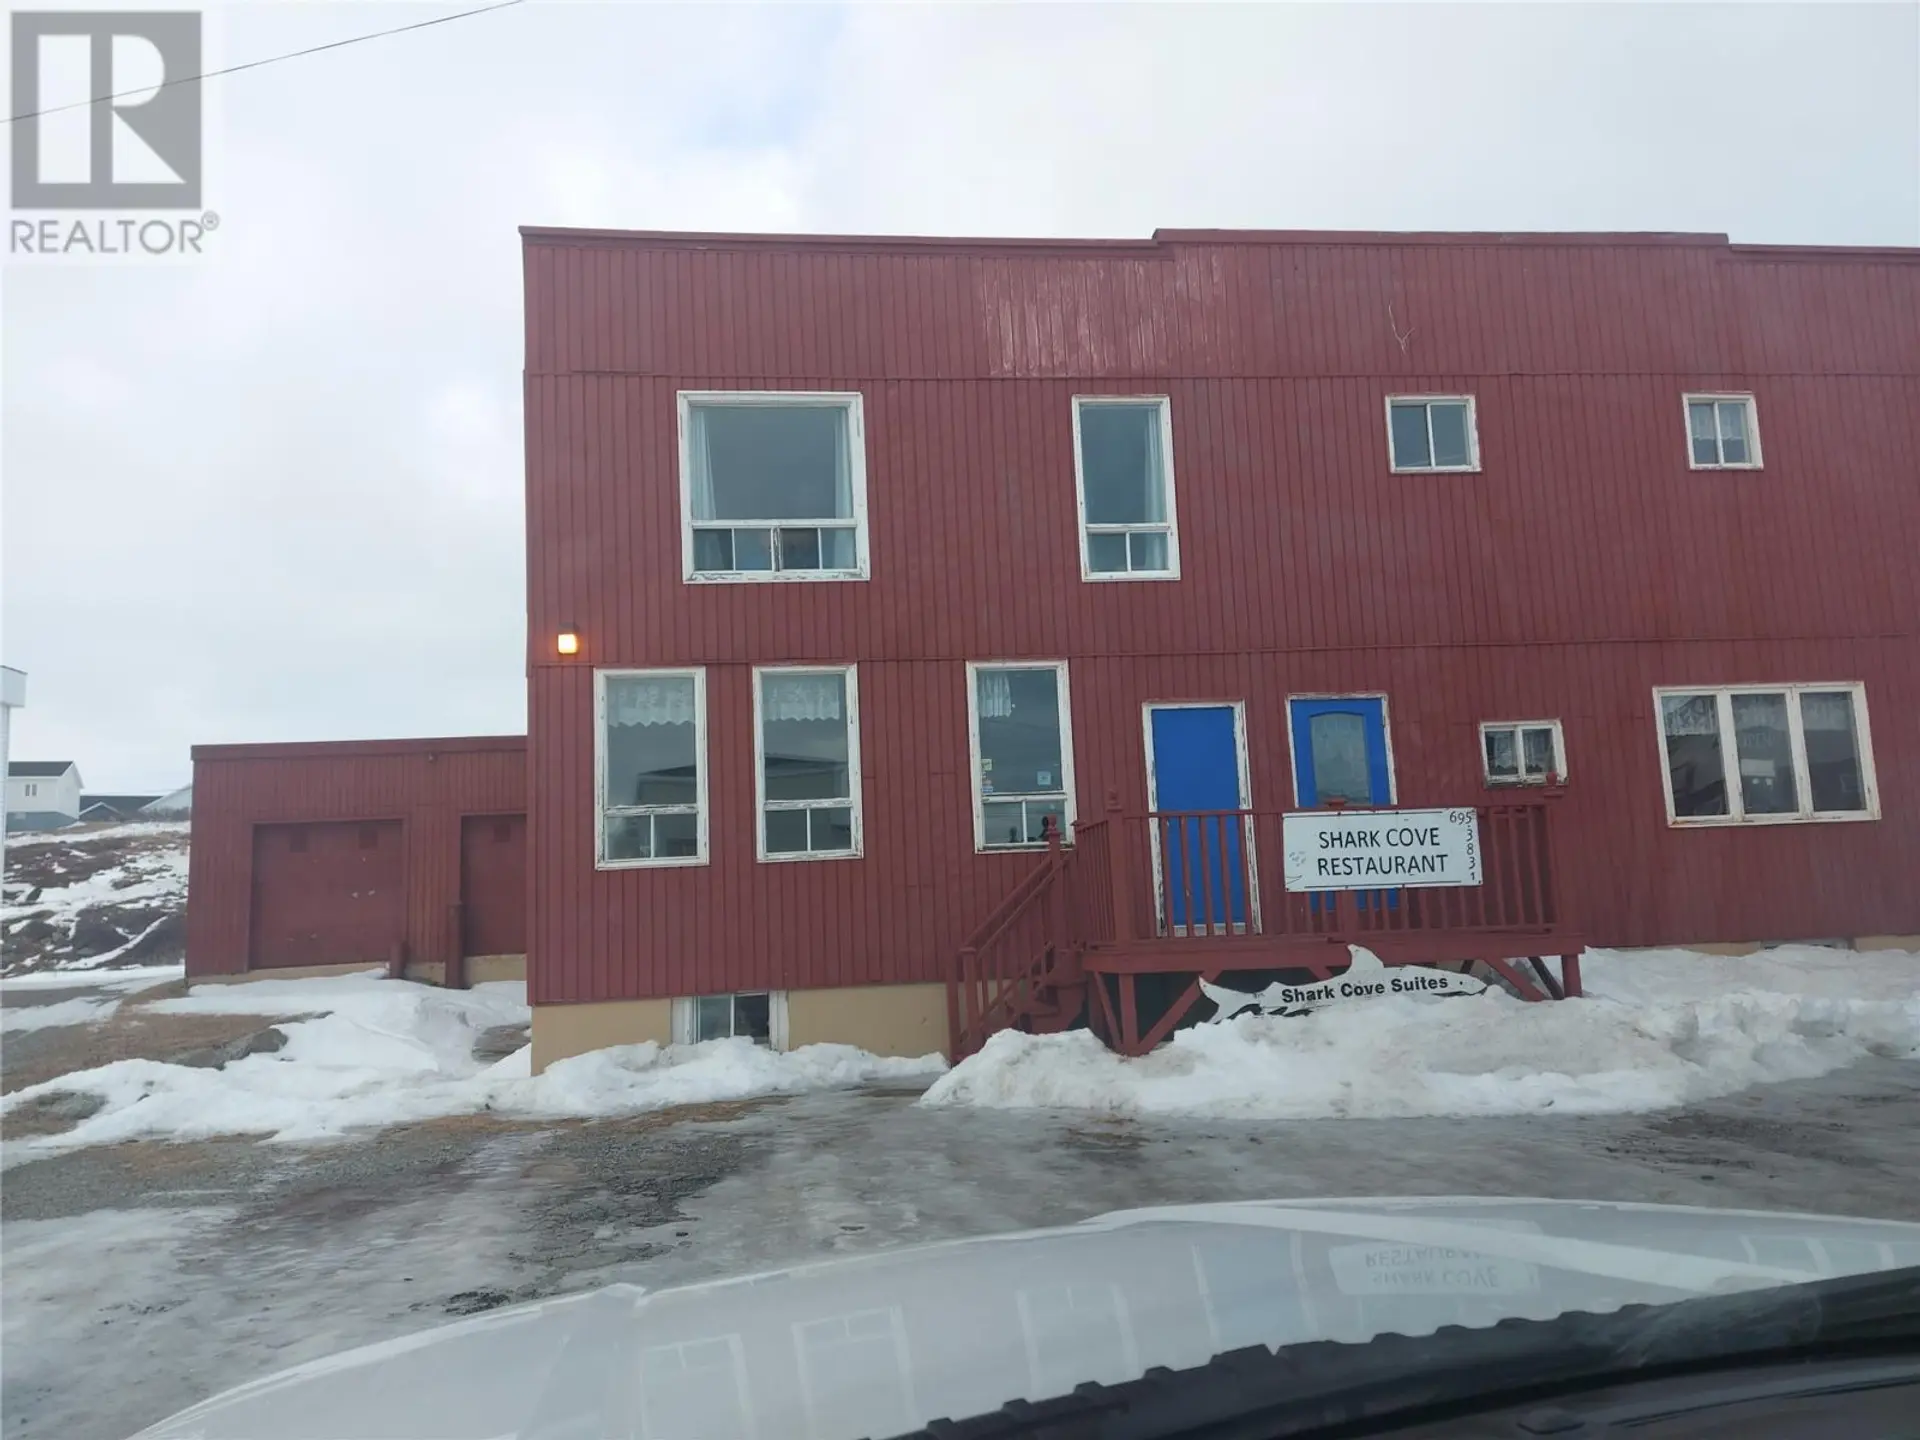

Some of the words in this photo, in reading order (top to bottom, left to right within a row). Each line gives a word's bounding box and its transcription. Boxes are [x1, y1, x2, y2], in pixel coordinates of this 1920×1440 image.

[1449, 810, 1473, 825] 695
[1318, 829, 1381, 849] SHARK
[1386, 827, 1441, 847] COVE
[1317, 853, 1449, 877] RESTAURANT
[1281, 984, 1336, 1004] Shark
[1340, 981, 1385, 998] Cove
[1391, 975, 1449, 992] Suites
